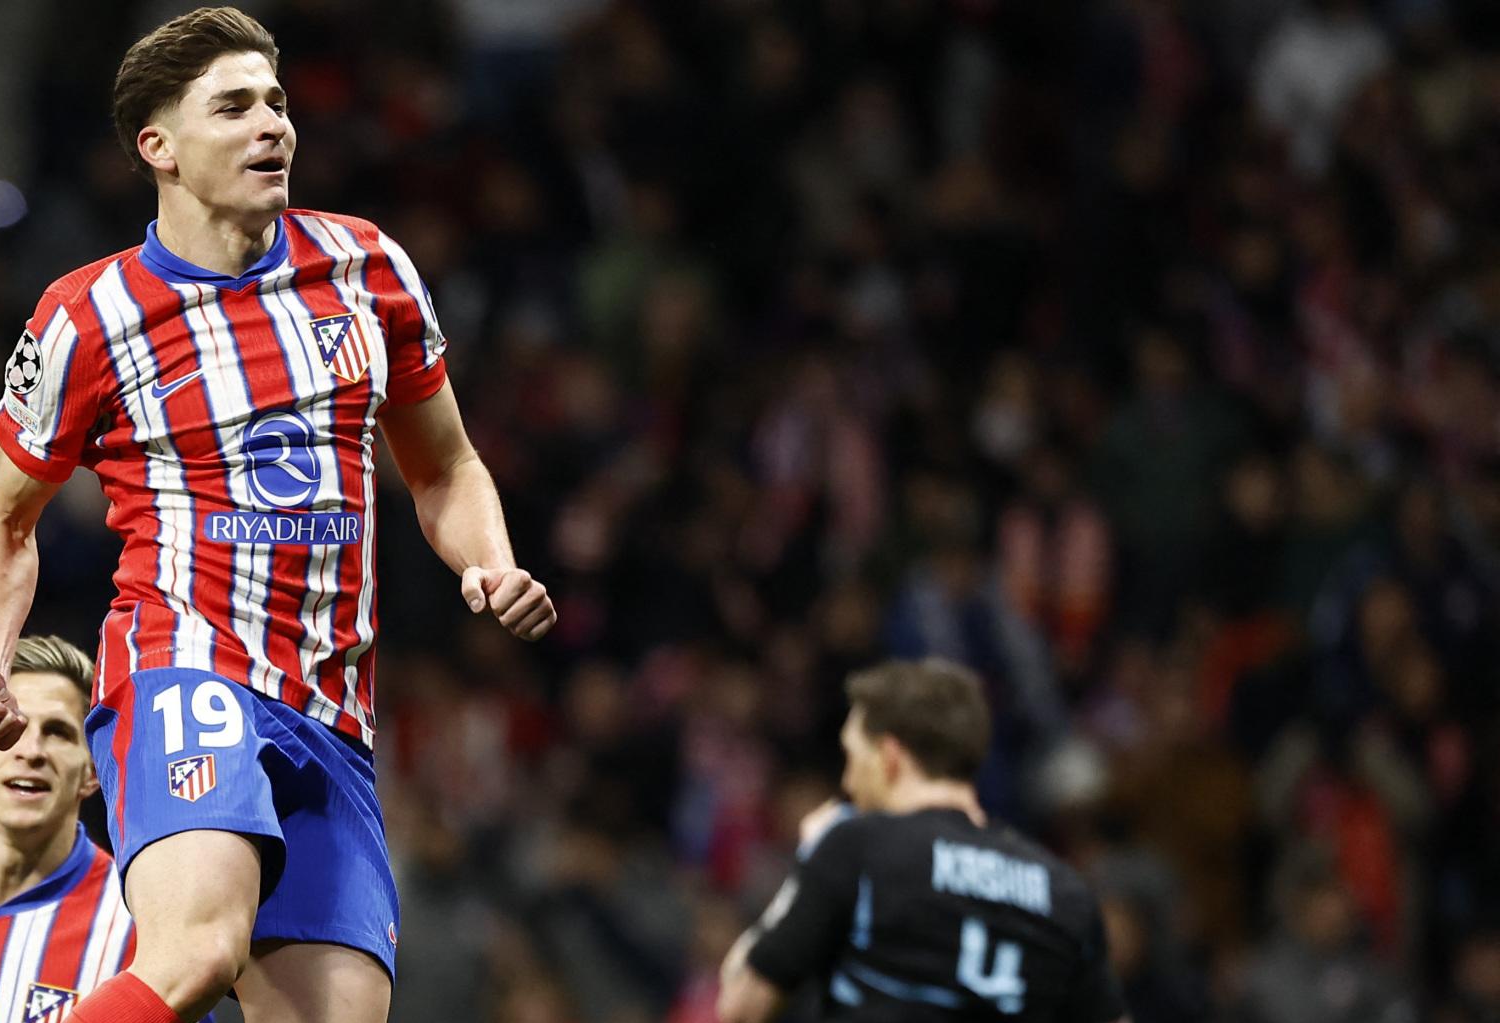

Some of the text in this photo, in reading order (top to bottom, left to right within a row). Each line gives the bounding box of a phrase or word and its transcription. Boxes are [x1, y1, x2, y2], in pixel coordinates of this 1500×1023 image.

[211, 515, 359, 541] RIYADH AIR
[152, 680, 244, 756] 19
[956, 918, 1027, 1014] 4
